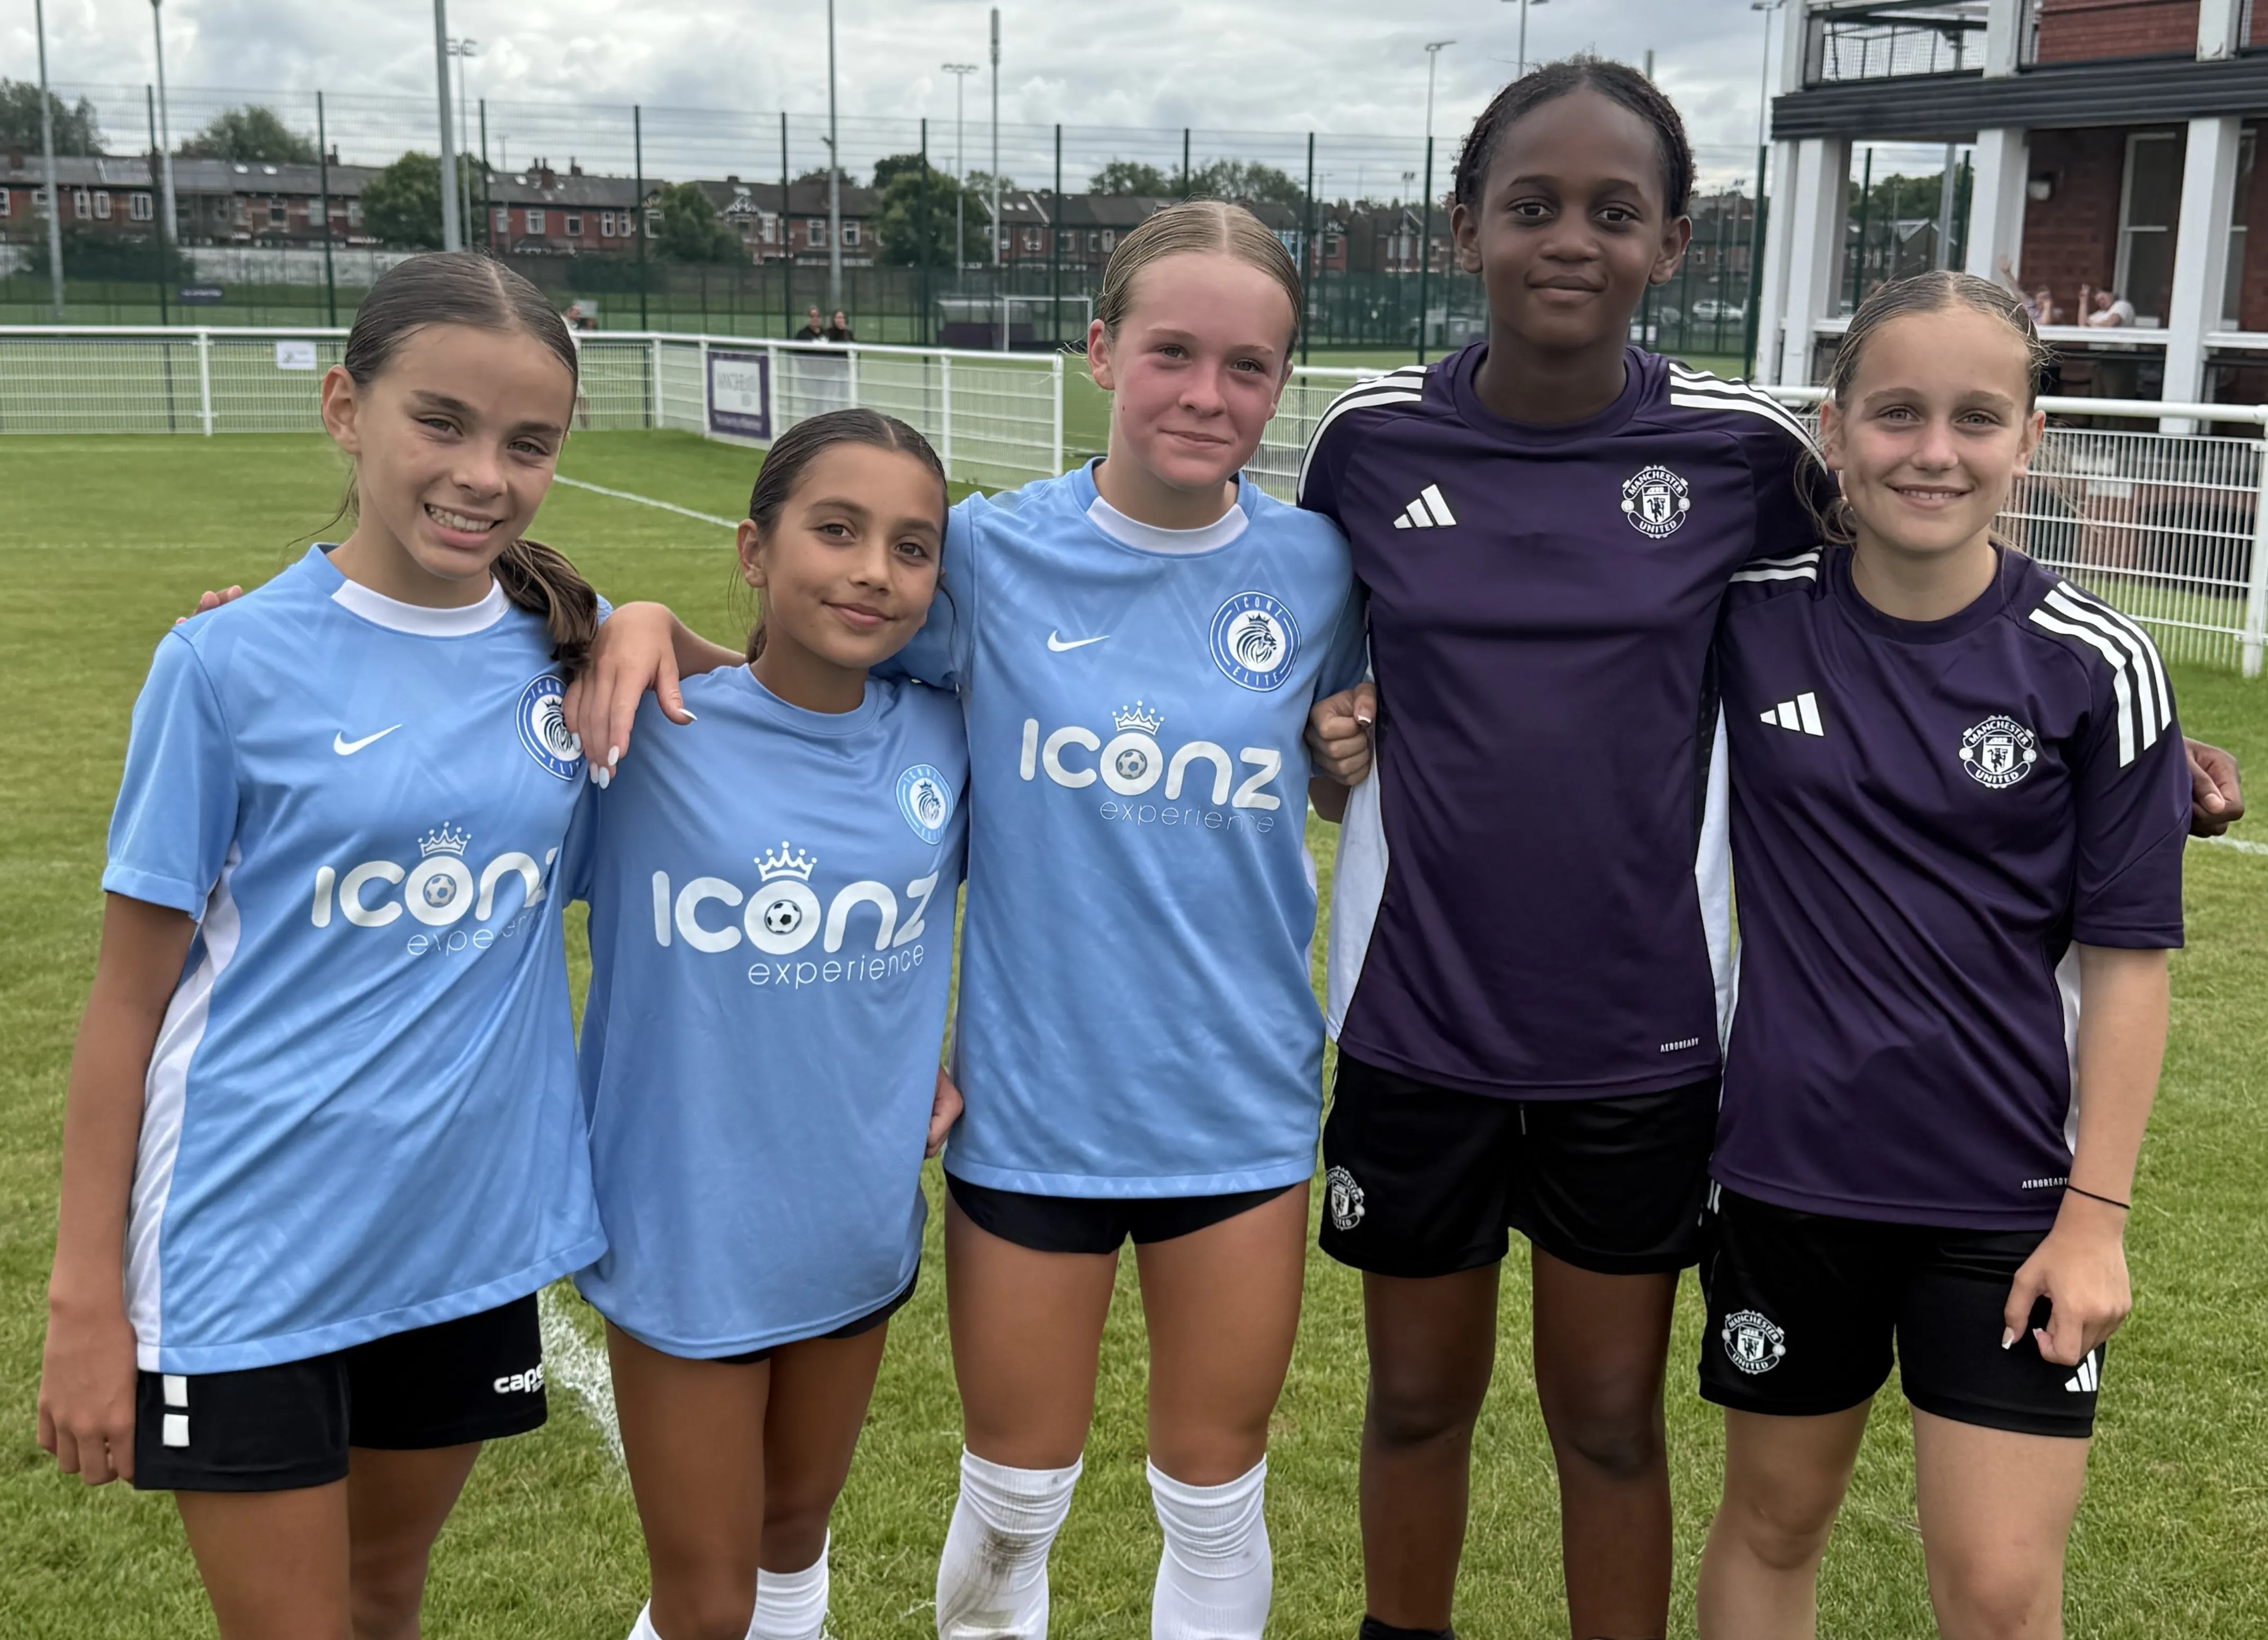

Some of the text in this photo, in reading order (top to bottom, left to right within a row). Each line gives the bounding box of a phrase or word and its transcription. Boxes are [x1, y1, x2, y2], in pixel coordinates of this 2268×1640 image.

[1628, 471, 1684, 495] MANCHESTER
[1639, 520, 1677, 533] UNITED
[1234, 596, 1282, 618] ICONZ
[1232, 666, 1278, 686] ELITE
[530, 679, 561, 698] ICON
[1968, 721, 2029, 746] MANCHESTER
[1975, 769, 2019, 784] UNITED
[748, 944, 924, 990] experience
